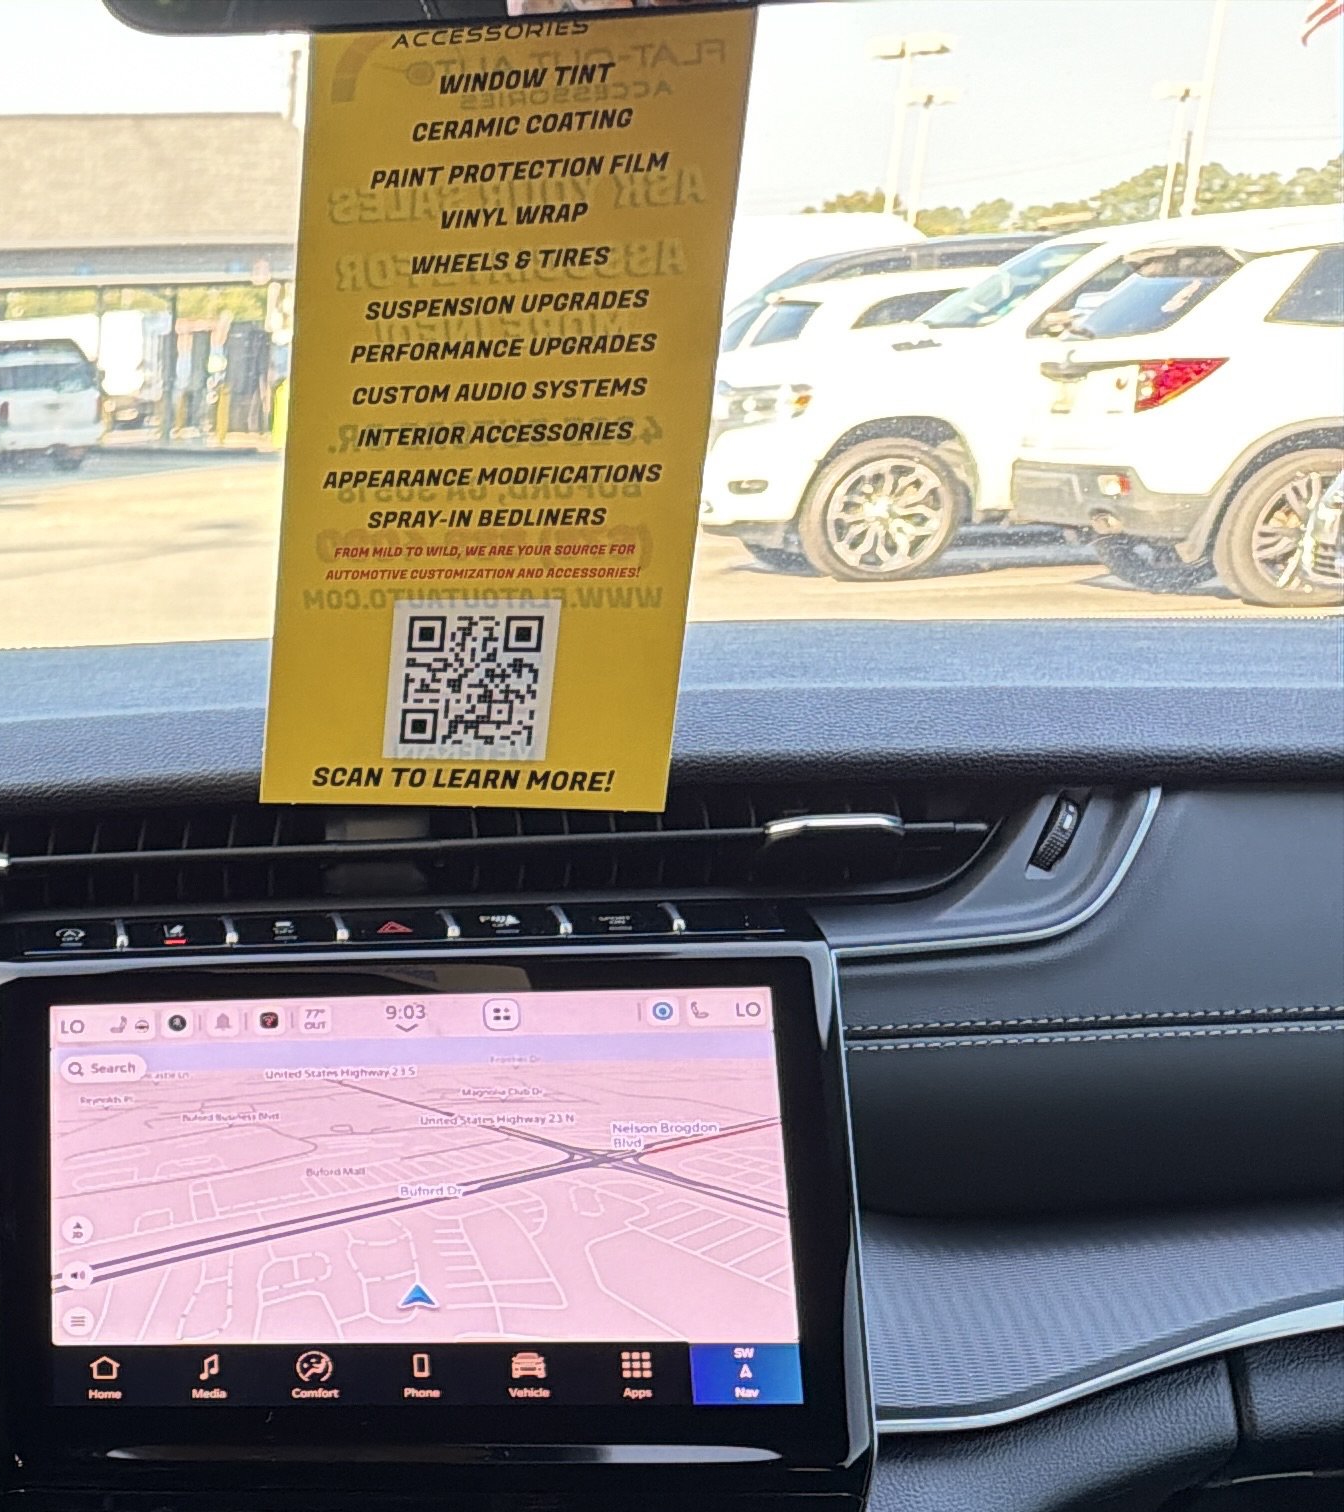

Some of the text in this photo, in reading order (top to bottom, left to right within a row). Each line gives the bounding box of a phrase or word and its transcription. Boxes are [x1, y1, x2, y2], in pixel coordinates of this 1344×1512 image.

[391, 20, 590, 50] ACCESSORIES
[438, 62, 616, 96] WINDOW TINT
[412, 107, 634, 143] CERAMIC COATING
[370, 151, 670, 190] PAINT PROTECTION FILM
[440, 202, 590, 231] VINYL WRAP
[411, 245, 611, 276] WHEELS & TIRES
[365, 288, 650, 321] SUSPENSION UPGRADES
[350, 333, 658, 364] PERFORMANCE UPGRADES
[352, 376, 649, 406] CUSTOM AUDIO SYSTEMS
[356, 425, 466, 449] INTERIOR
[469, 420, 634, 446] ACCESSORIES
[322, 463, 662, 490] APPEARANCE MODIFICATIONS
[367, 507, 607, 530] SPRAY-IN BEDLINERS
[334, 543, 636, 559] FROM MILD TO WILD, WE ARE YOUR SOURCE FOR
[325, 566, 642, 581] AUTOMOTIVE CUSTOMIZATION AND ACCESSORIES!
[312, 766, 616, 793] SCAN TO LEARN MORE!
[385, 1004, 427, 1021] 9:03
[734, 1001, 762, 1020] LO
[61, 1020, 85, 1035] LO
[304, 1020, 327, 1031] OUT
[90, 1061, 137, 1075] Search
[265, 1068, 302, 1080] United
[304, 1068, 338, 1079] States
[340, 1067, 390, 1080] Highway
[420, 1113, 575, 1127] United States Highway 23 N
[612, 1121, 718, 1135] Nelson Brogdon
[613, 1137, 643, 1148] Blvd
[306, 1166, 366, 1177] Buford Mall
[734, 1347, 755, 1359] SW
[88, 1388, 122, 1399] Home
[192, 1388, 227, 1399] Media
[292, 1388, 339, 1399] Comfort
[404, 1387, 441, 1398] Phone
[508, 1387, 550, 1398] Vehicle
[623, 1387, 653, 1400] Apps
[734, 1387, 760, 1398] Nav
